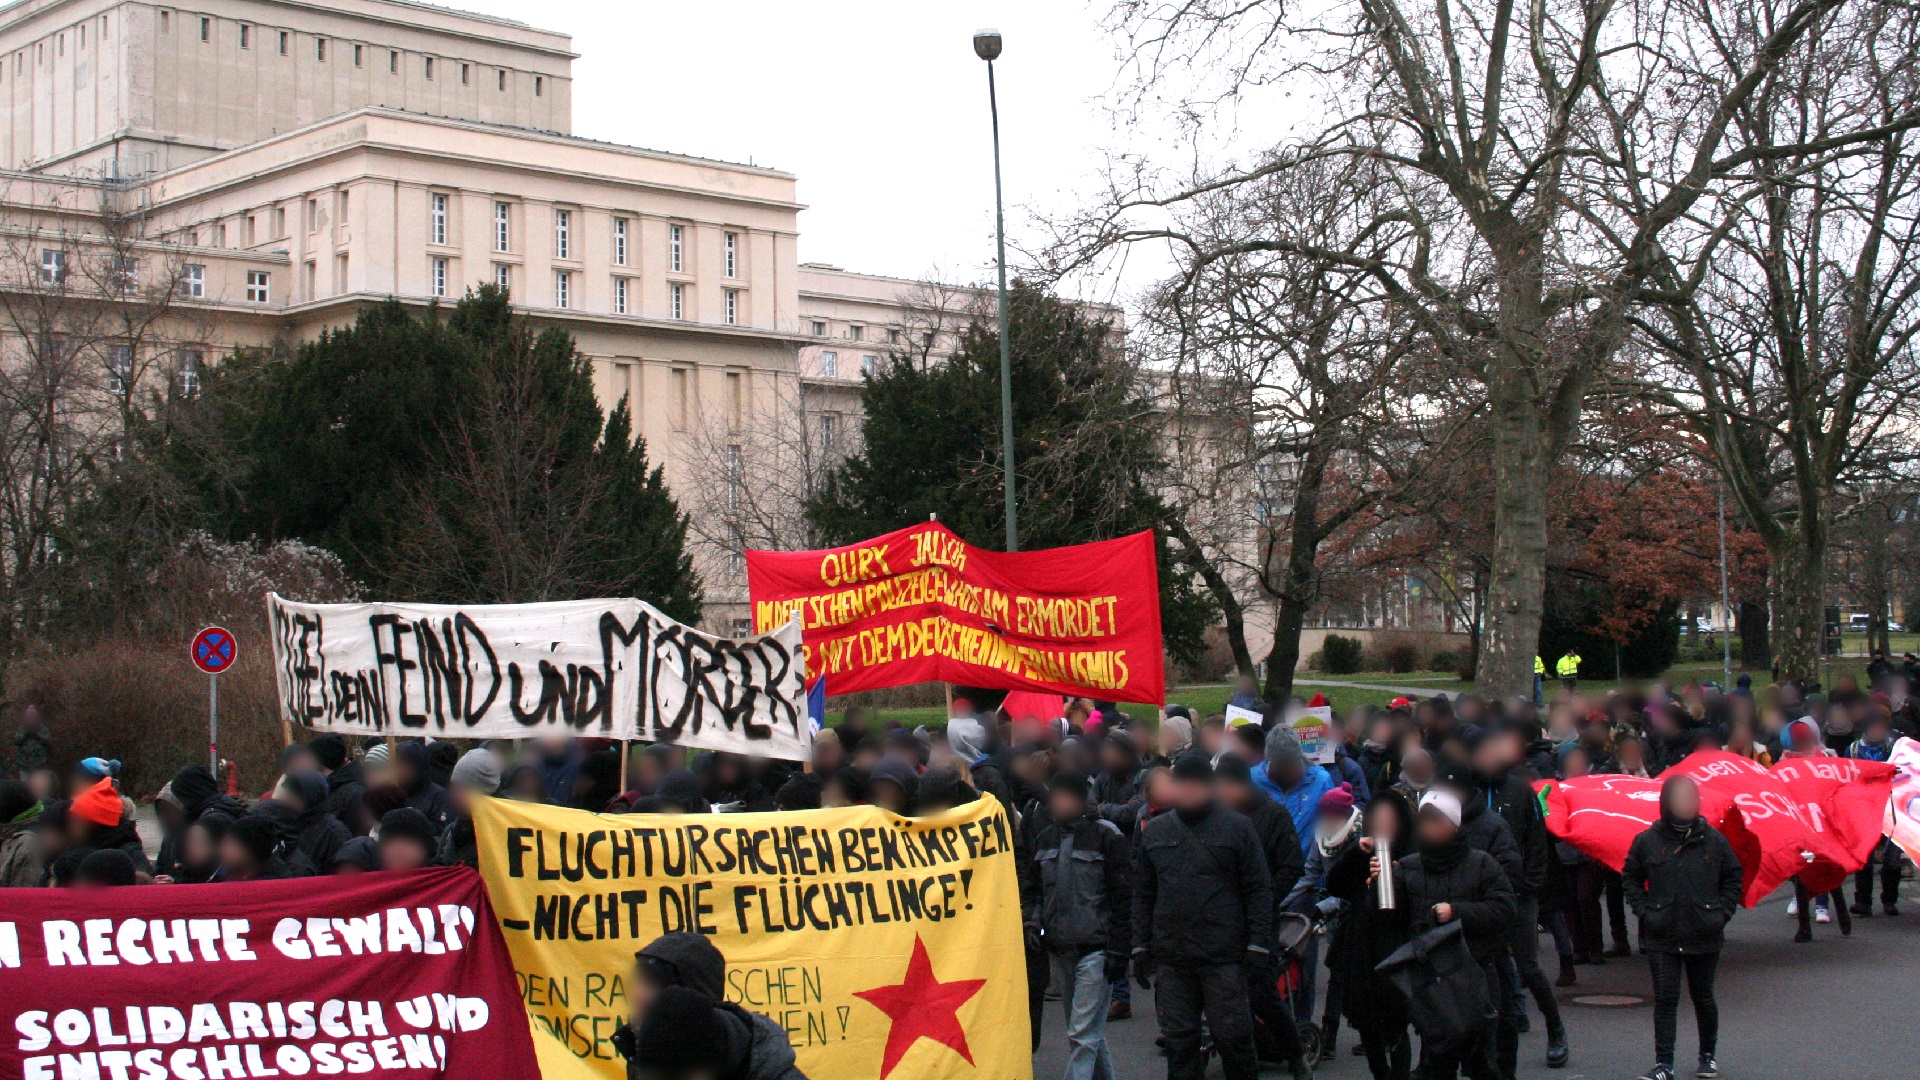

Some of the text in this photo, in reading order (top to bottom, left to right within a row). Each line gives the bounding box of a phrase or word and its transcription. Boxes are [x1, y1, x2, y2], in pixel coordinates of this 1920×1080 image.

[820, 530, 968, 587] OURY JALLOH
[756, 600, 775, 635] IM
[1015, 595, 1118, 638] ERMORDET
[330, 669, 382, 732] DEIN
[369, 611, 500, 730] FEIND
[508, 659, 603, 729] UND
[819, 635, 858, 675] MIT
[859, 622, 908, 667] DEM
[507, 814, 1010, 881] FLUCHTURSACHEN BEKÄMPFEN
[660, 880, 719, 935] DIE
[734, 868, 975, 934] FLÜCHTLINGE!
[42, 917, 258, 967] RECHTE
[14, 993, 490, 1051] SOLIDARISCH UND
[22, 1033, 447, 1080] ENTSCHLOSSEN!
